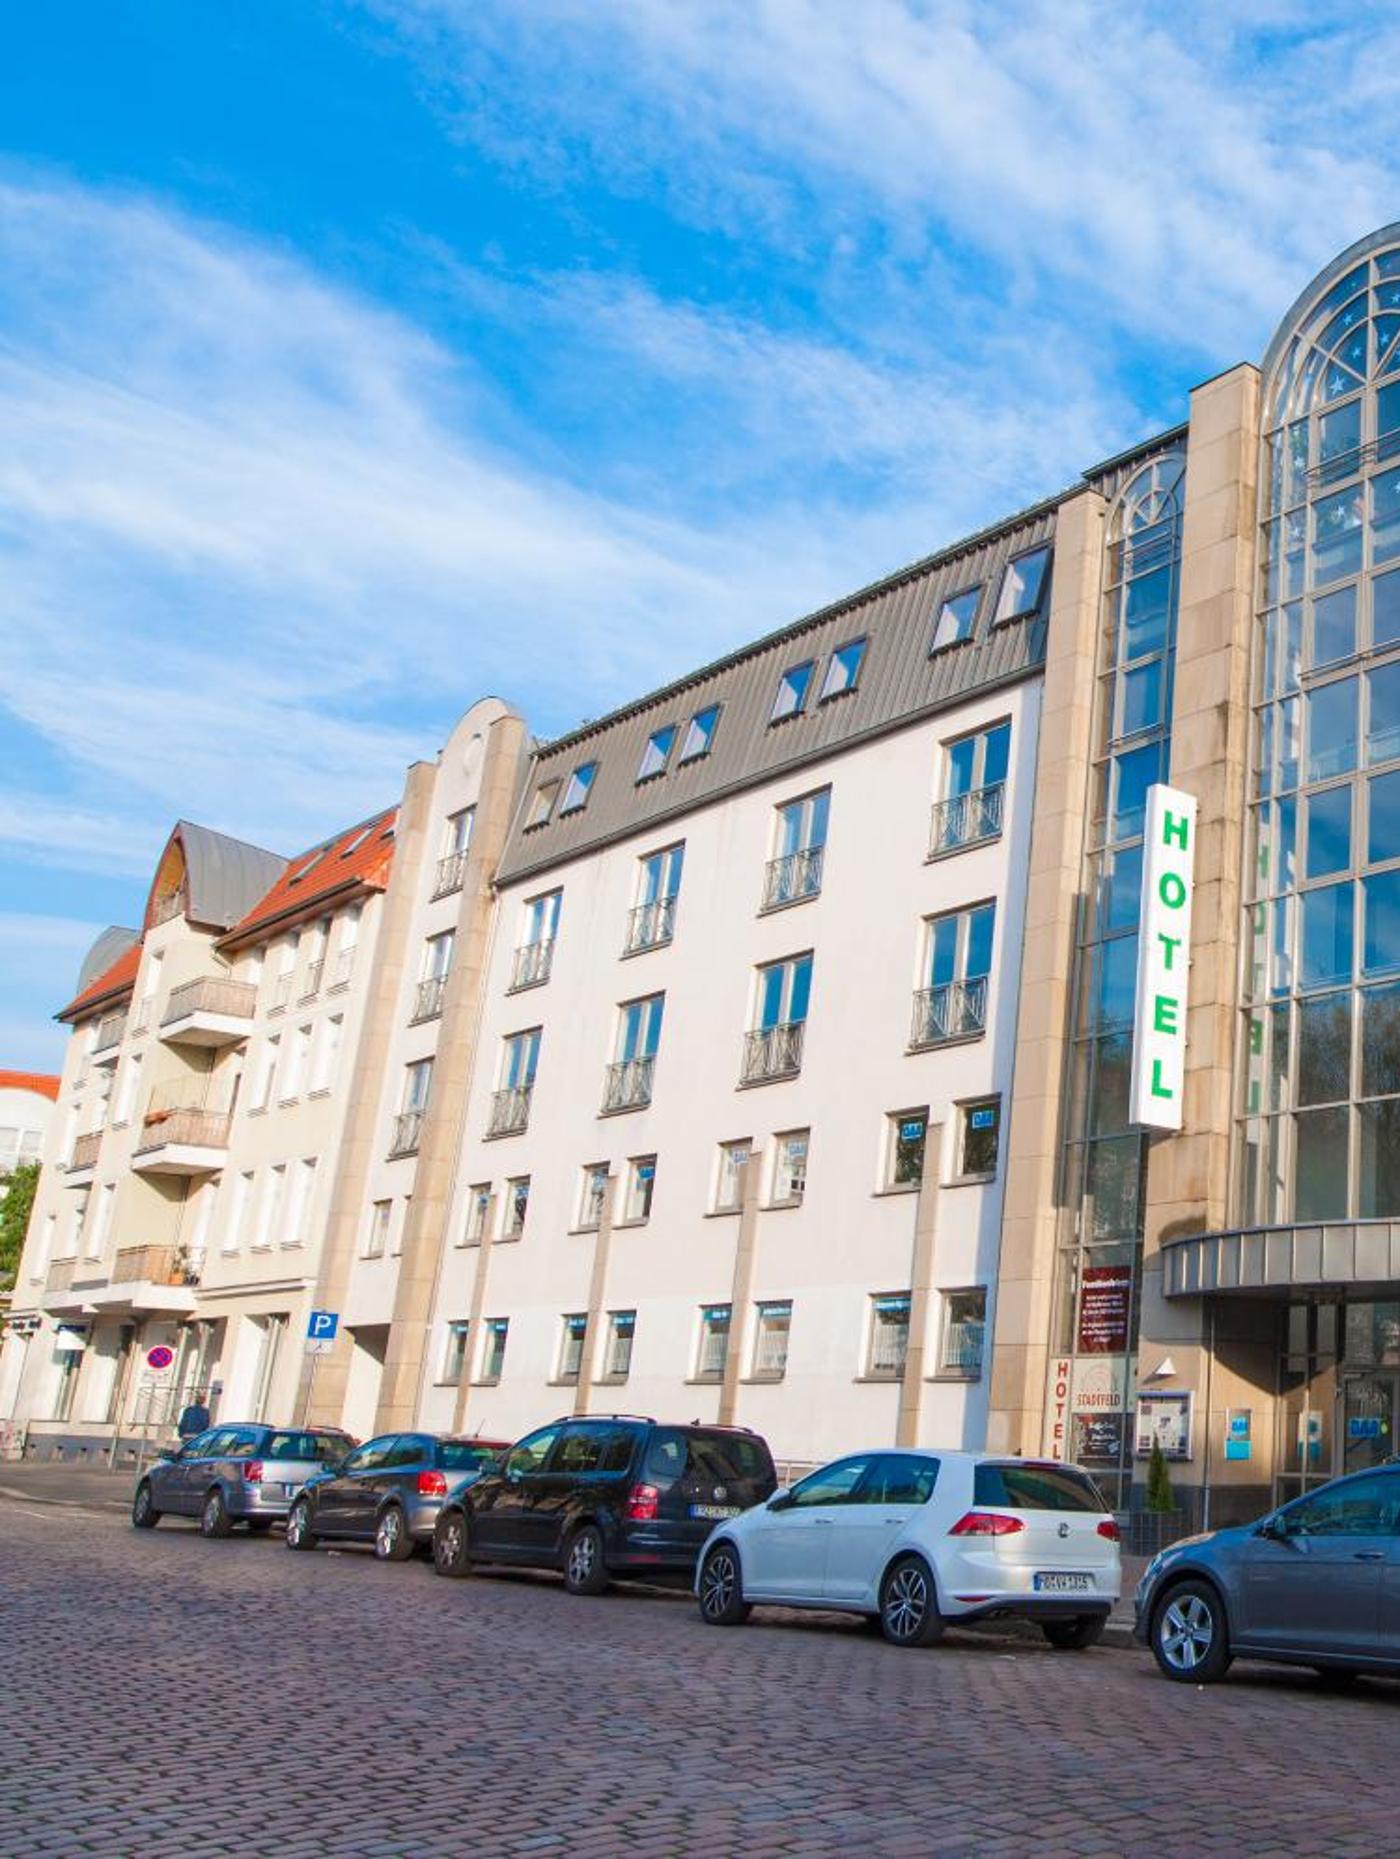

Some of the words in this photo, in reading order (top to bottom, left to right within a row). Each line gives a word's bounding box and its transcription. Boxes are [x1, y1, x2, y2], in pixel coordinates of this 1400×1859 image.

[1150, 810, 1190, 1099] HOTEL
[314, 1315, 331, 1335] P
[1077, 1394, 1121, 1406] STADTFELD
[1053, 1362, 1068, 1459] HOTEL
[1350, 1418, 1378, 1436] DAA
